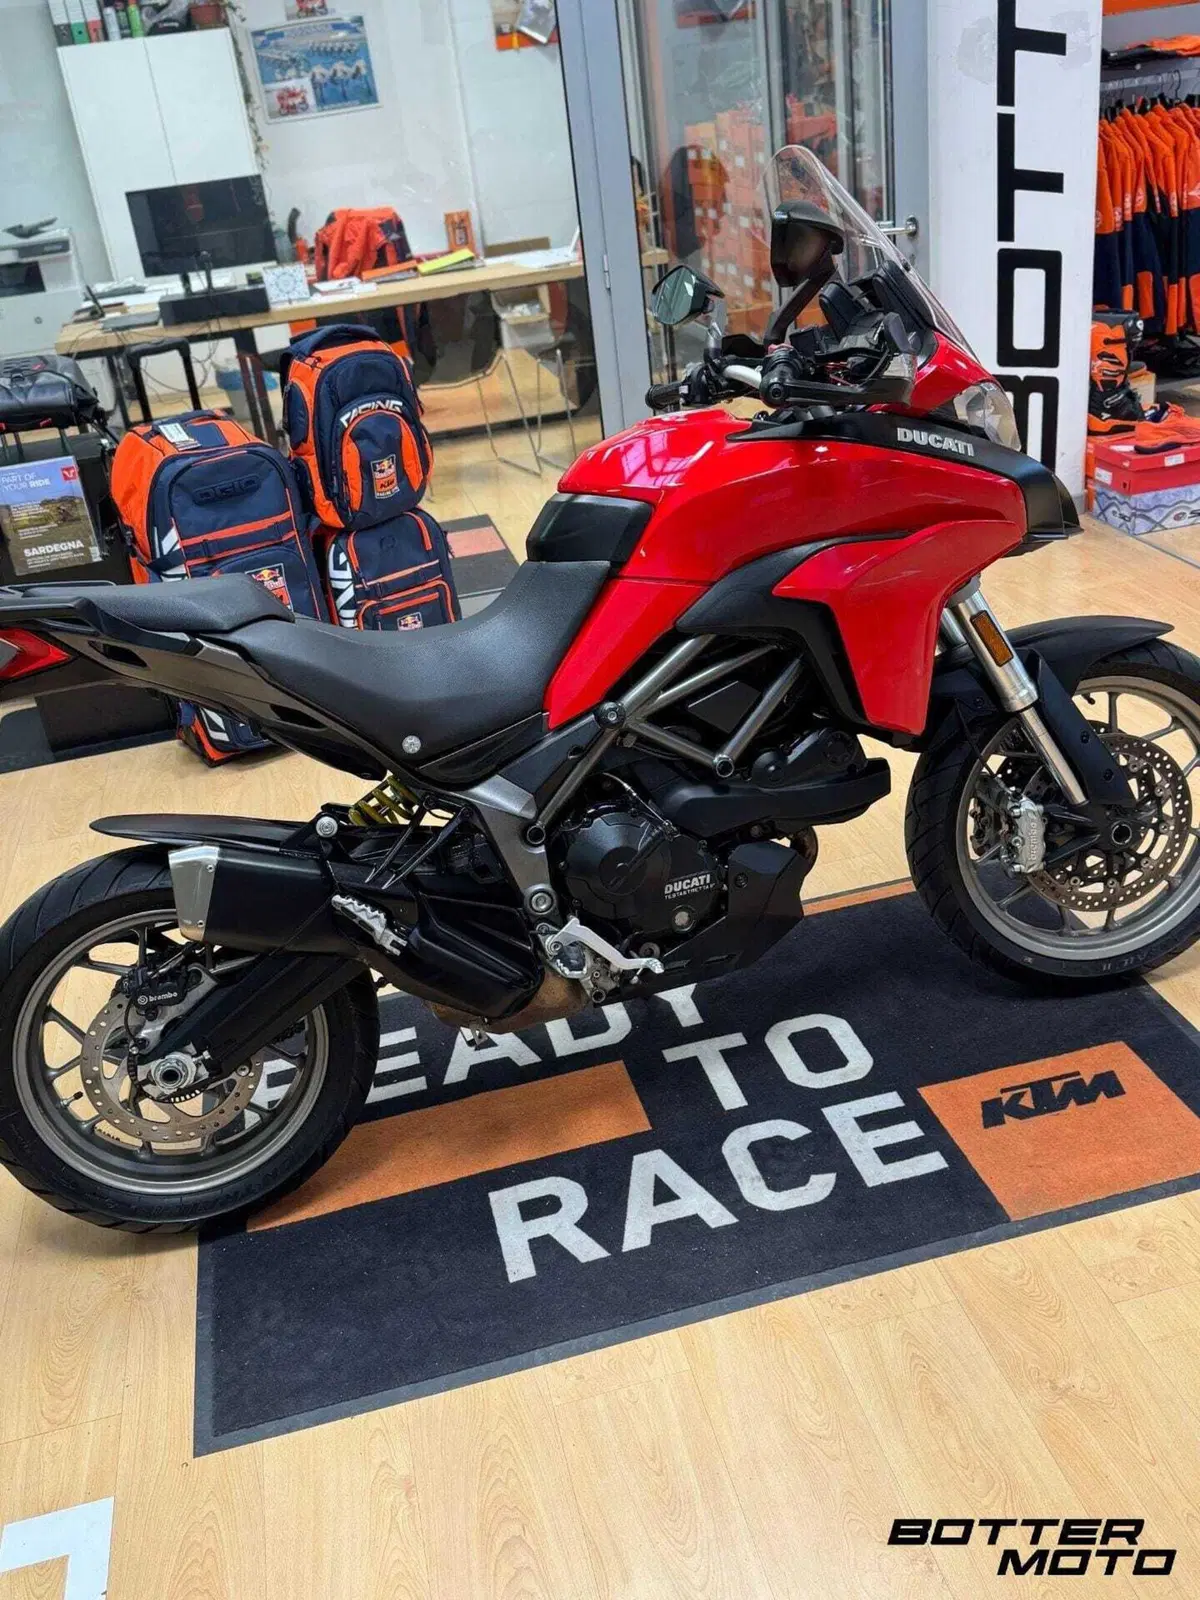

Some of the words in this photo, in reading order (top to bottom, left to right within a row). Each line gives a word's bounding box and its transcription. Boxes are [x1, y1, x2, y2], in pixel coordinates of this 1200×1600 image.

[897, 427, 974, 457] DUCATI
[29, 478, 50, 488] RIDE
[23, 540, 84, 557] SARDEGNA
[1028, 822, 1037, 861] brembo
[664, 874, 711, 895] DUCATI
[149, 991, 178, 1002] brembo
[661, 1013, 875, 1111] TO
[981, 1070, 1126, 1129] KTM
[487, 1091, 949, 1284] RACE
